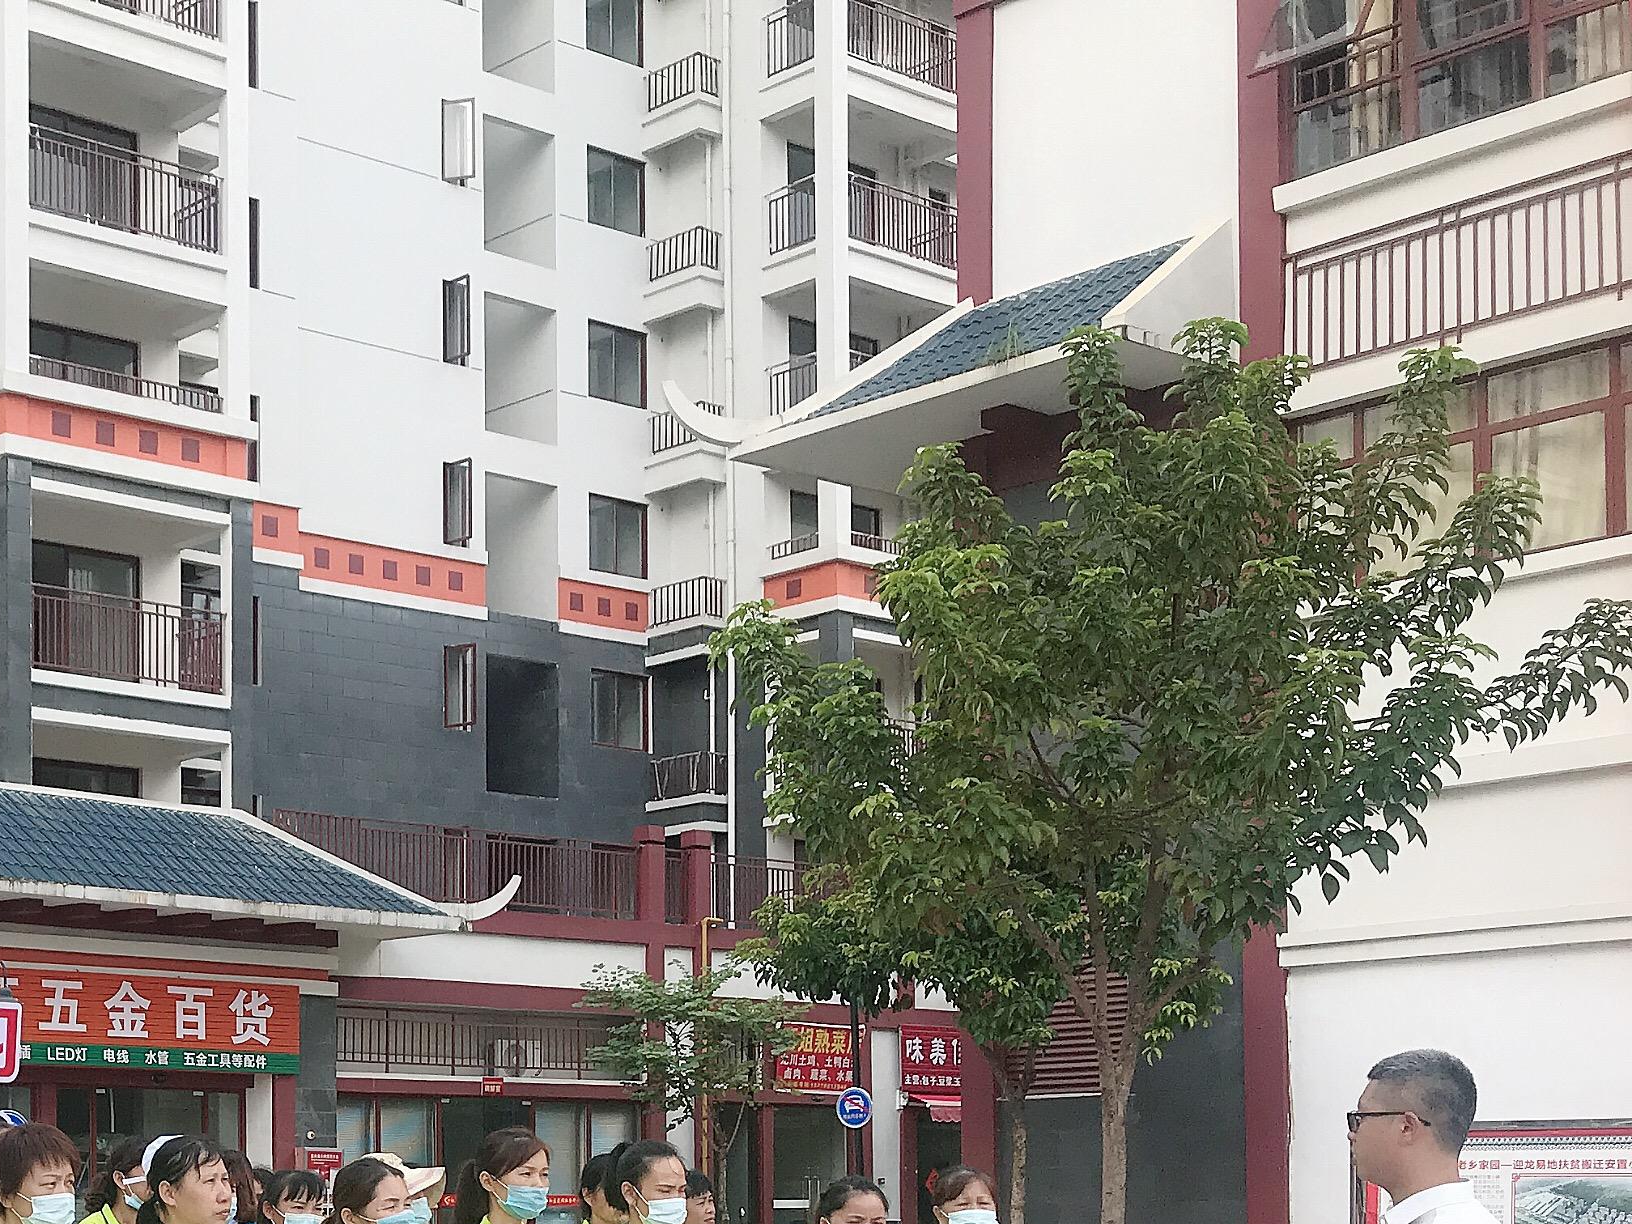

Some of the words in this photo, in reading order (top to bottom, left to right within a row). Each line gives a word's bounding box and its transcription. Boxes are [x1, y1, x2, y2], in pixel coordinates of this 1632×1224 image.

[46, 1046, 88, 1063] LED灯
[102, 1047, 130, 1064] 电线
[144, 1049, 169, 1066] 水管
[183, 1051, 267, 1070] 五金工具等配件
